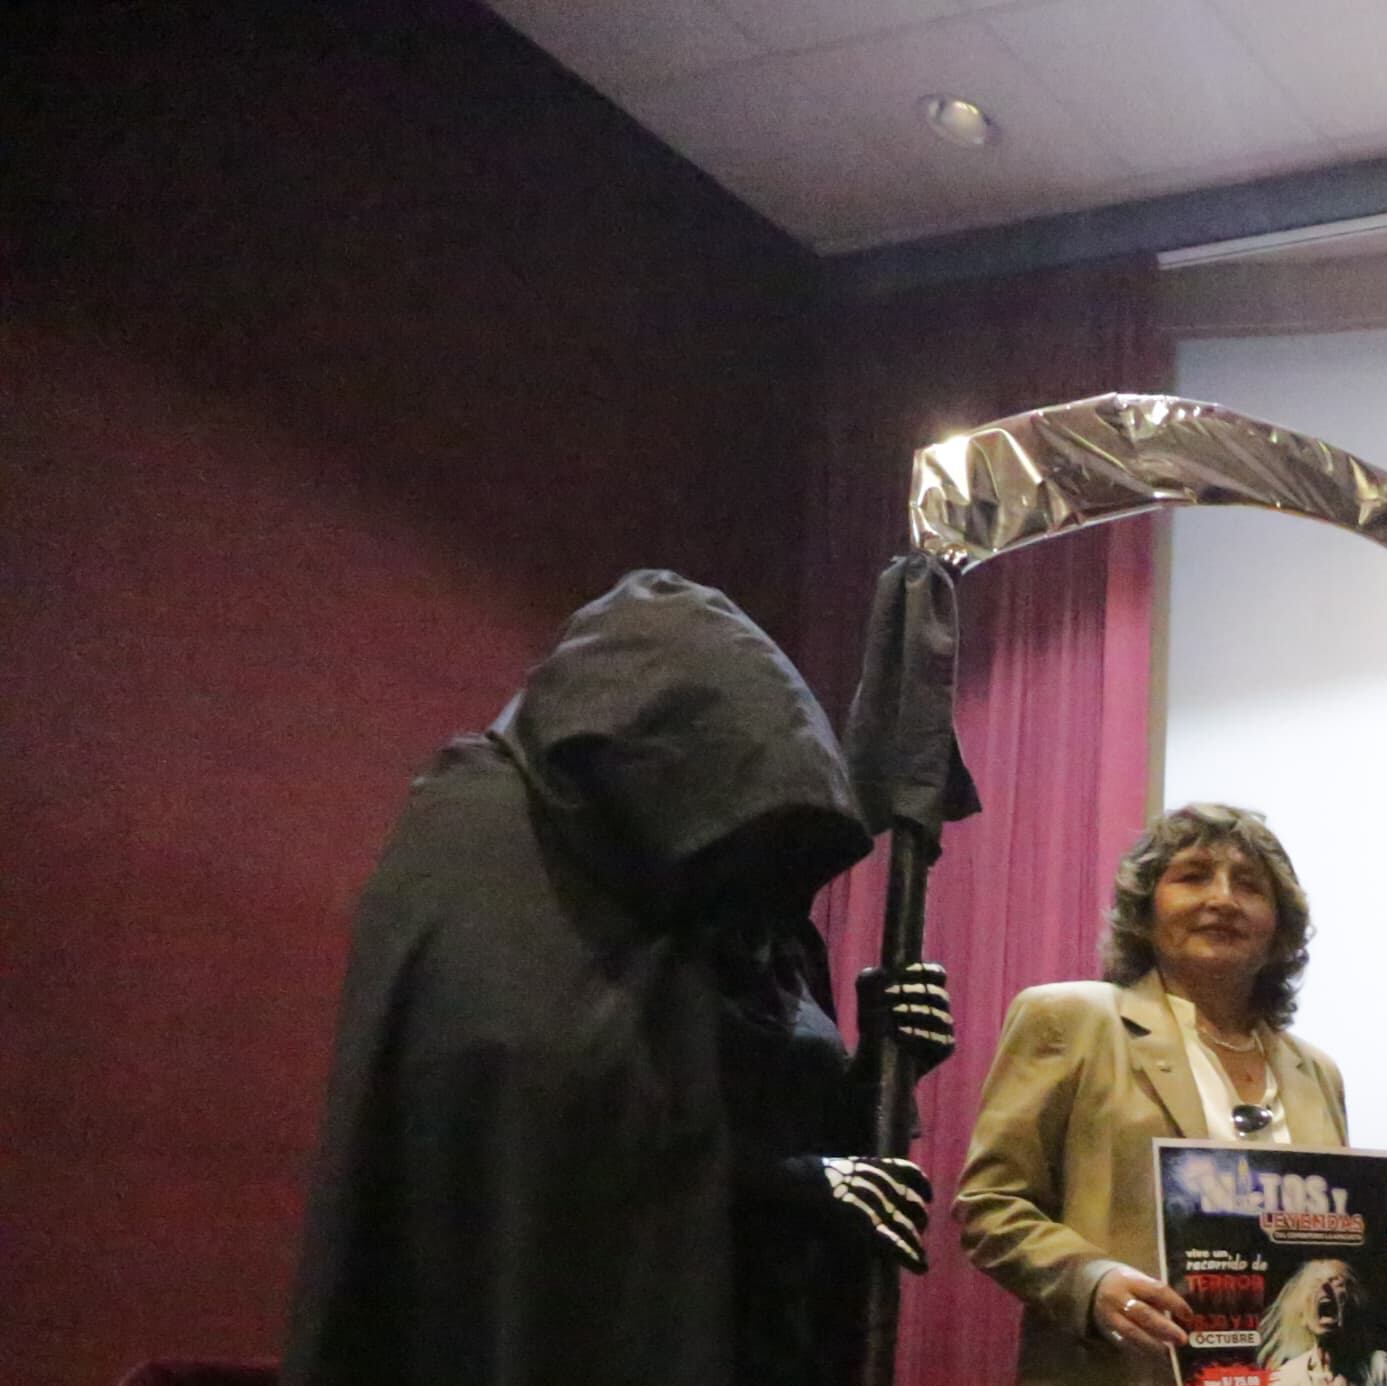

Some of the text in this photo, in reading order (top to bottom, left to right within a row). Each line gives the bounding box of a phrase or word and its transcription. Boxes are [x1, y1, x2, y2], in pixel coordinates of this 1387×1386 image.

[1261, 1212, 1364, 1231] LEYENDAS
[1185, 1248, 1210, 1258] vive
[1186, 1253, 1268, 1271] recorrido de
[1185, 1274, 1264, 1297] TERROR
[1195, 1333, 1254, 1344] OCTUBRE
